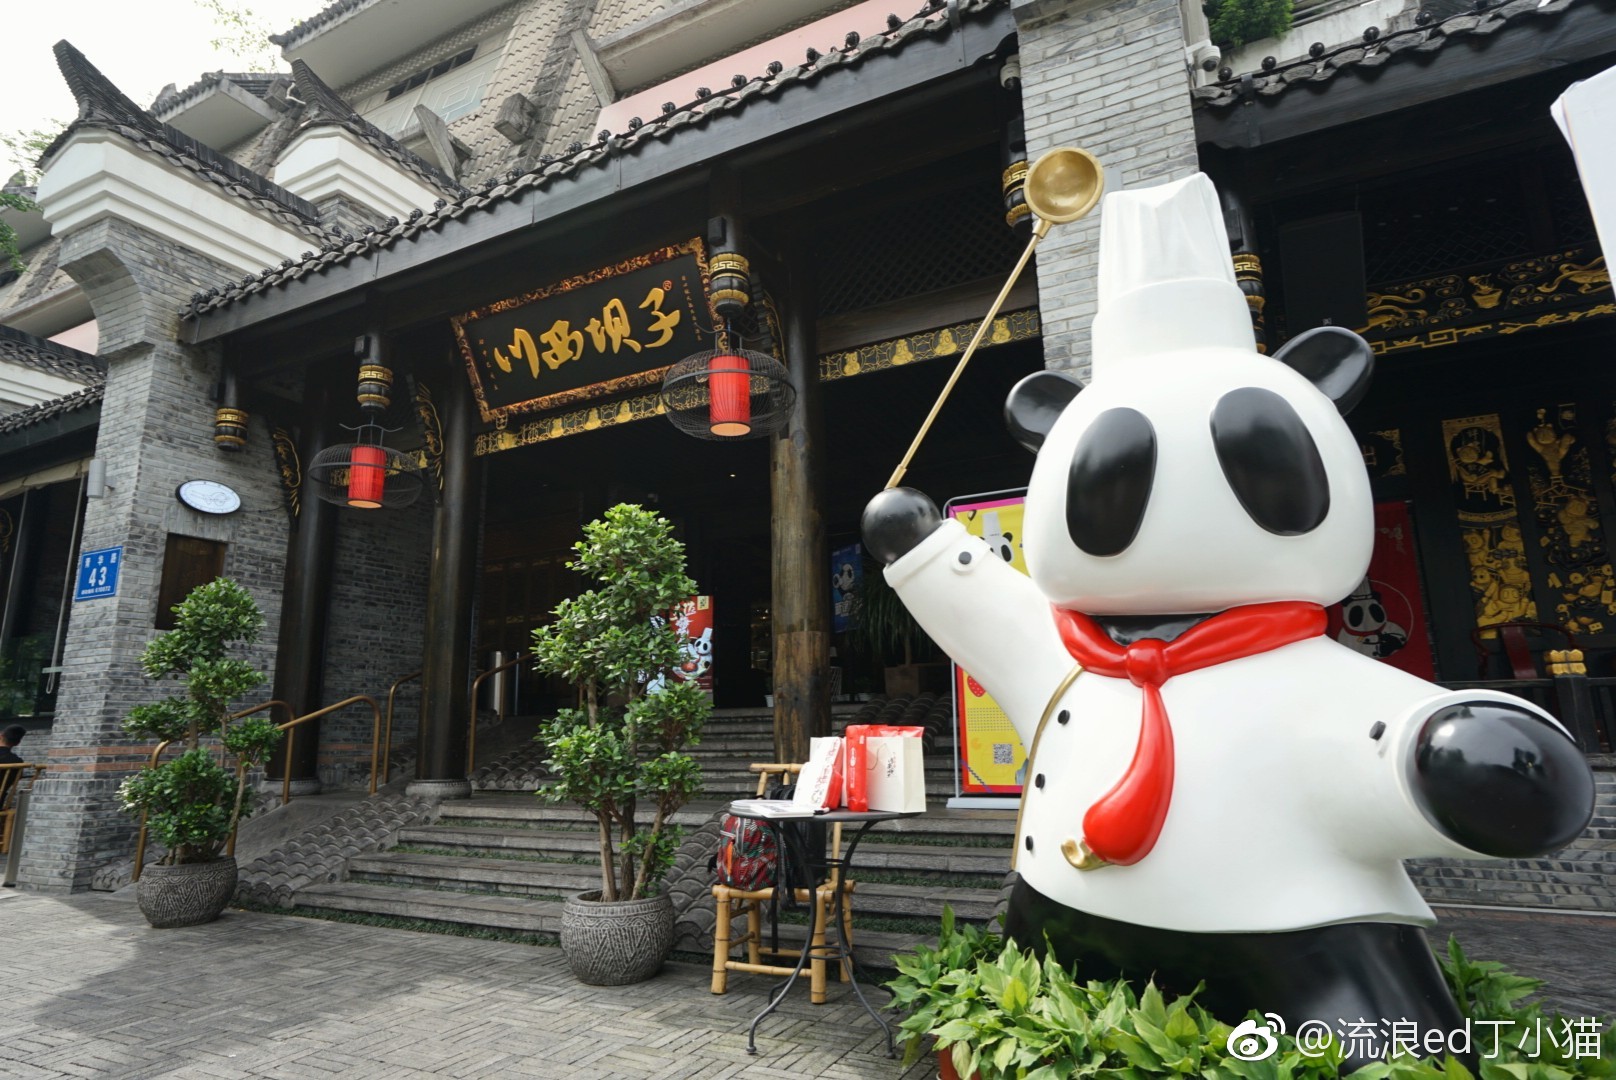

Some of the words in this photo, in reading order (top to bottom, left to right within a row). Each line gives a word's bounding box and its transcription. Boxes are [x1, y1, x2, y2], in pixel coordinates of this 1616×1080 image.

[493, 287, 681, 380] 川西坝子
[88, 566, 107, 586] 43
